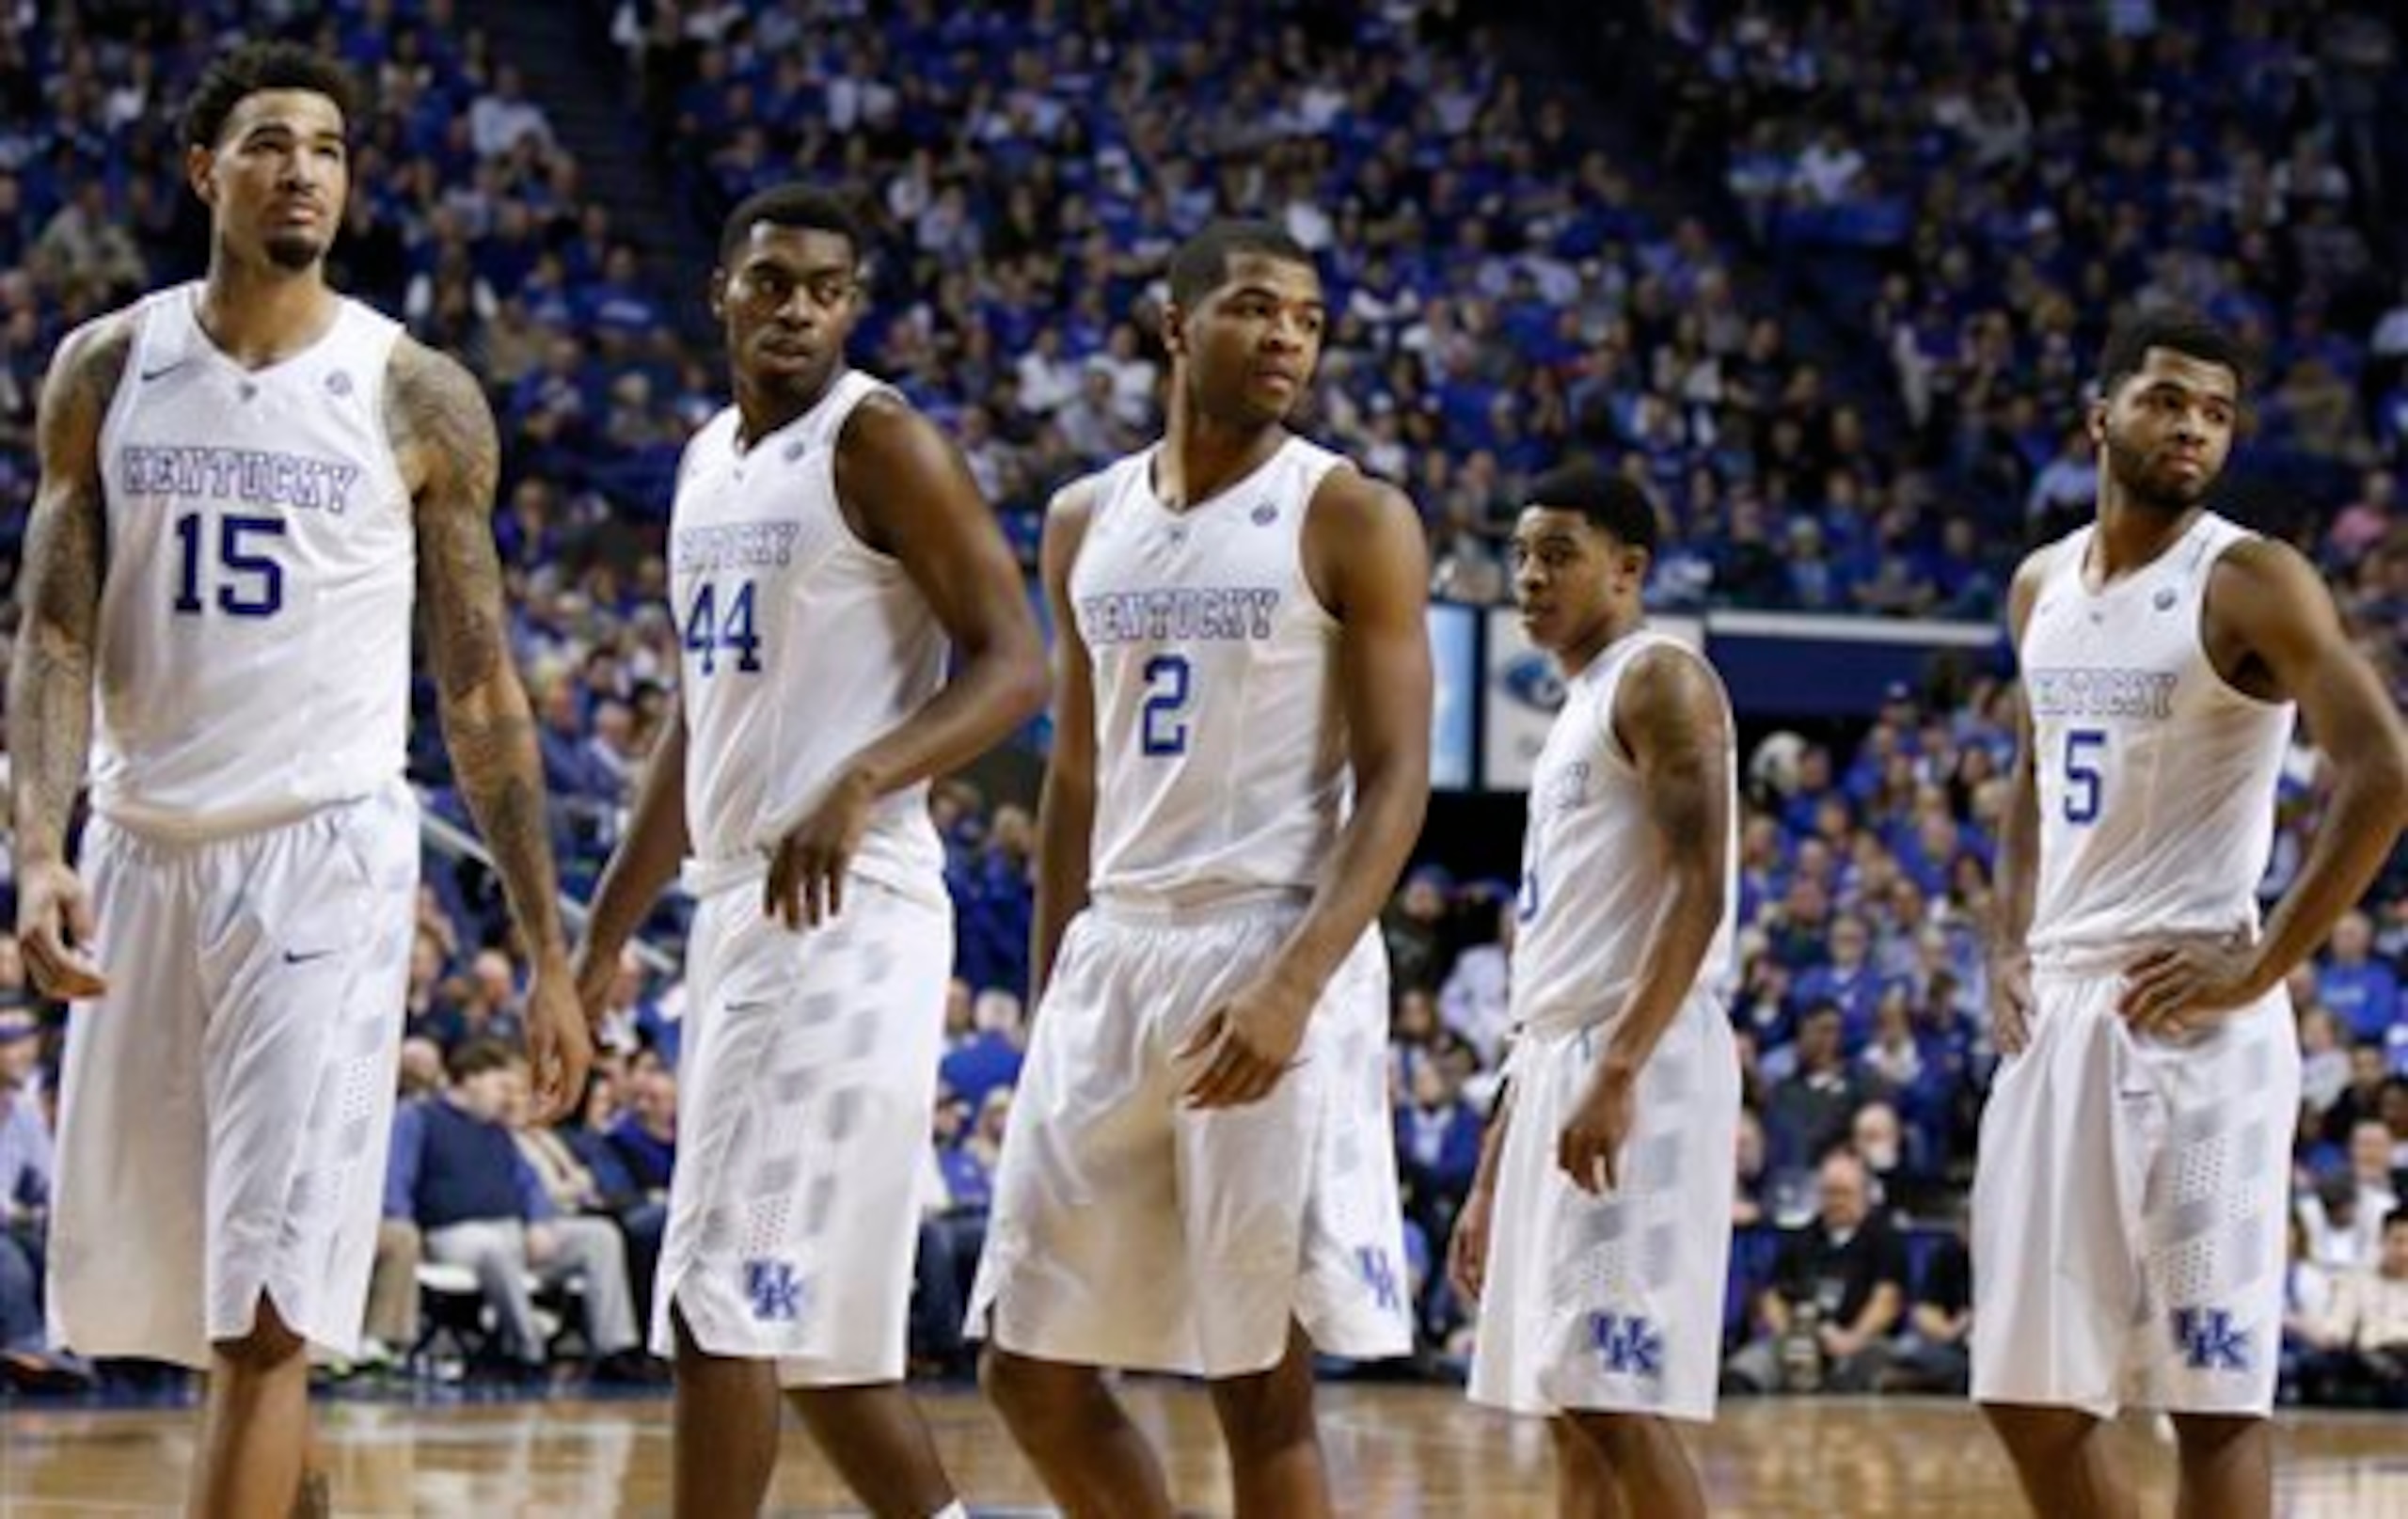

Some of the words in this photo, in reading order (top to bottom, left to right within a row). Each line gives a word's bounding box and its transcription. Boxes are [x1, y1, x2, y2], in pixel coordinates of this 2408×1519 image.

[122, 447, 359, 515] KENTUCKY
[175, 514, 286, 617] 15
[684, 580, 762, 675] 44
[1142, 655, 1190, 756] 2
[2031, 667, 2178, 720] ENTUCKY
[2063, 729, 2106, 825] 5
[1588, 1309, 1662, 1379] UK
[2169, 1307, 2250, 1372] UK
